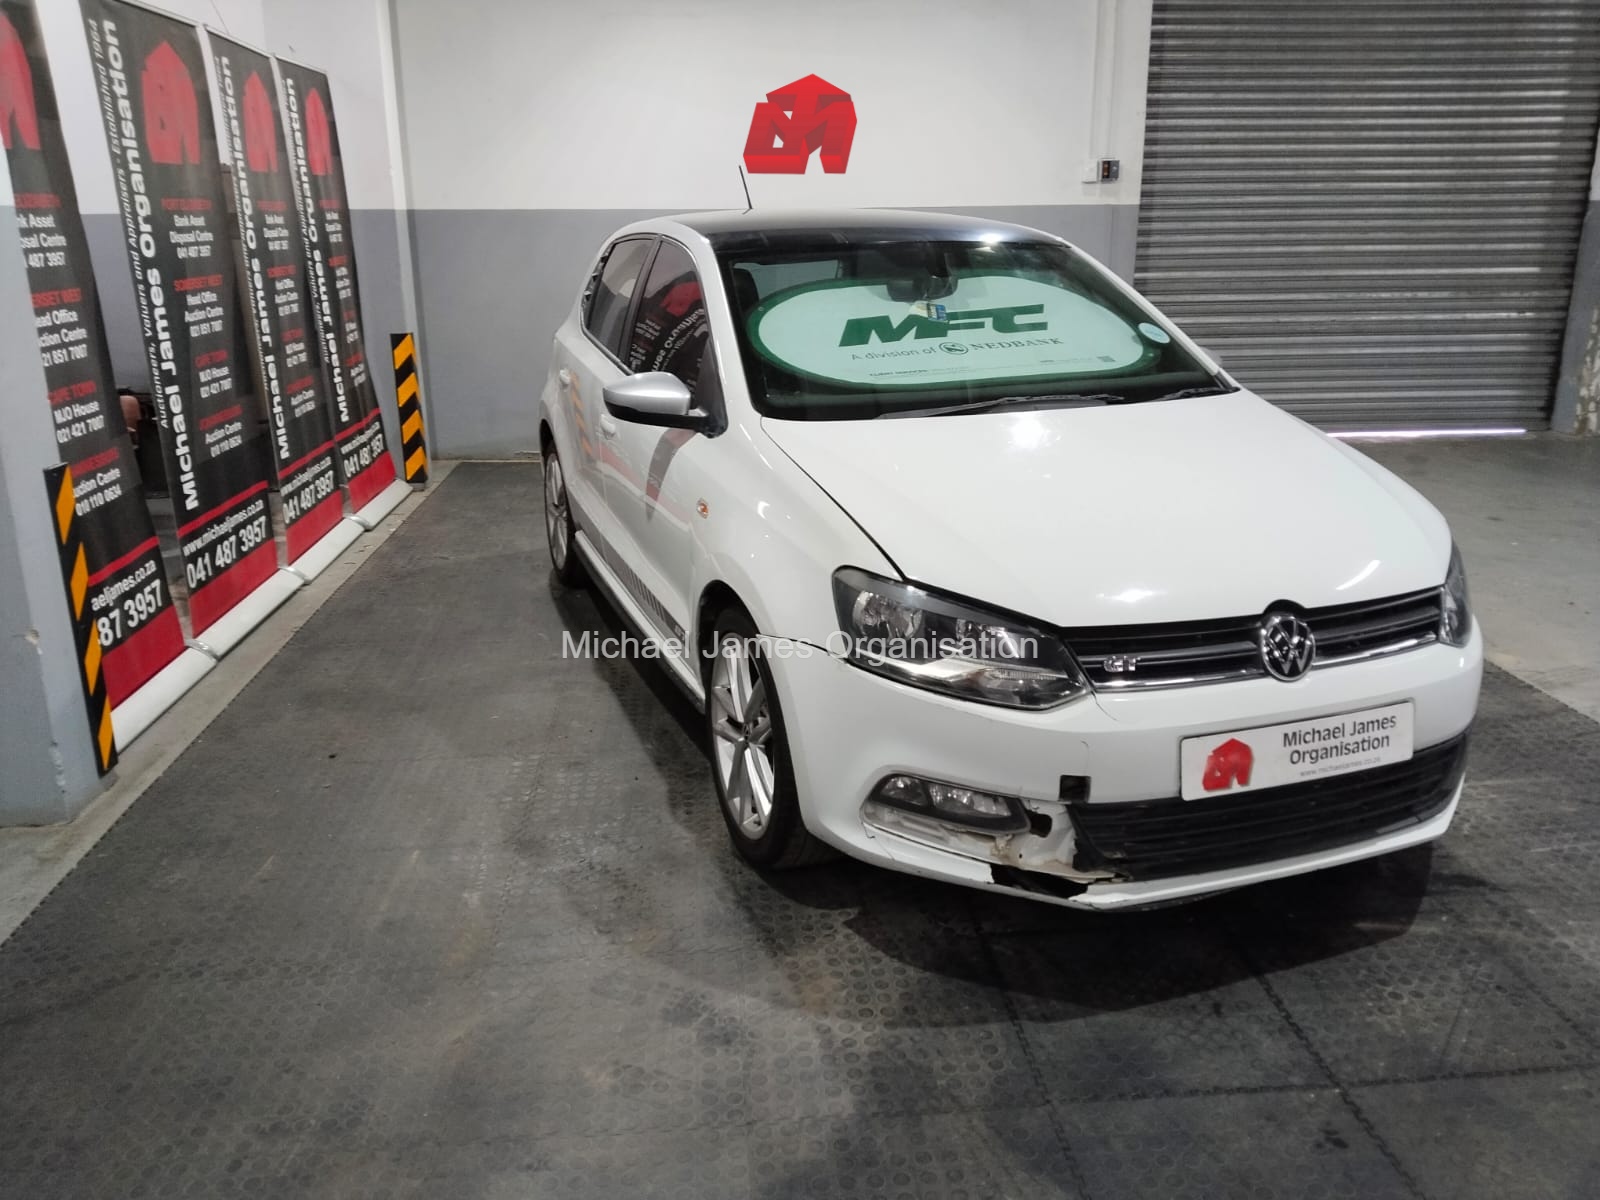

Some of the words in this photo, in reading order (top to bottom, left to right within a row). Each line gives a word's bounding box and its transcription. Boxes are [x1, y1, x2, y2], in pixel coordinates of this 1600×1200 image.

[103, 20, 155, 258] Organisation
[221, 56, 256, 250] Organisation
[131, 251, 143, 280] and
[251, 258, 272, 347] James
[313, 249, 332, 326] James
[147, 268, 176, 376] James
[865, 349, 920, 360] division
[922, 346, 938, 356] of
[969, 337, 1064, 351] NEDBANK
[71, 401, 100, 418] House
[265, 355, 289, 459] Michael
[326, 333, 350, 423] Michael
[165, 385, 199, 510] Michael
[282, 495, 300, 524] 041
[300, 484, 316, 510] 487
[315, 470, 335, 499] 3957
[186, 552, 213, 588] 041
[215, 535, 237, 567] 487
[238, 515, 266, 552] 3957
[96, 608, 122, 647] 87
[124, 578, 162, 628] 3957
[1283, 723, 1346, 748] Michael
[1350, 715, 1397, 737] James
[1289, 734, 1390, 765] Organisation
